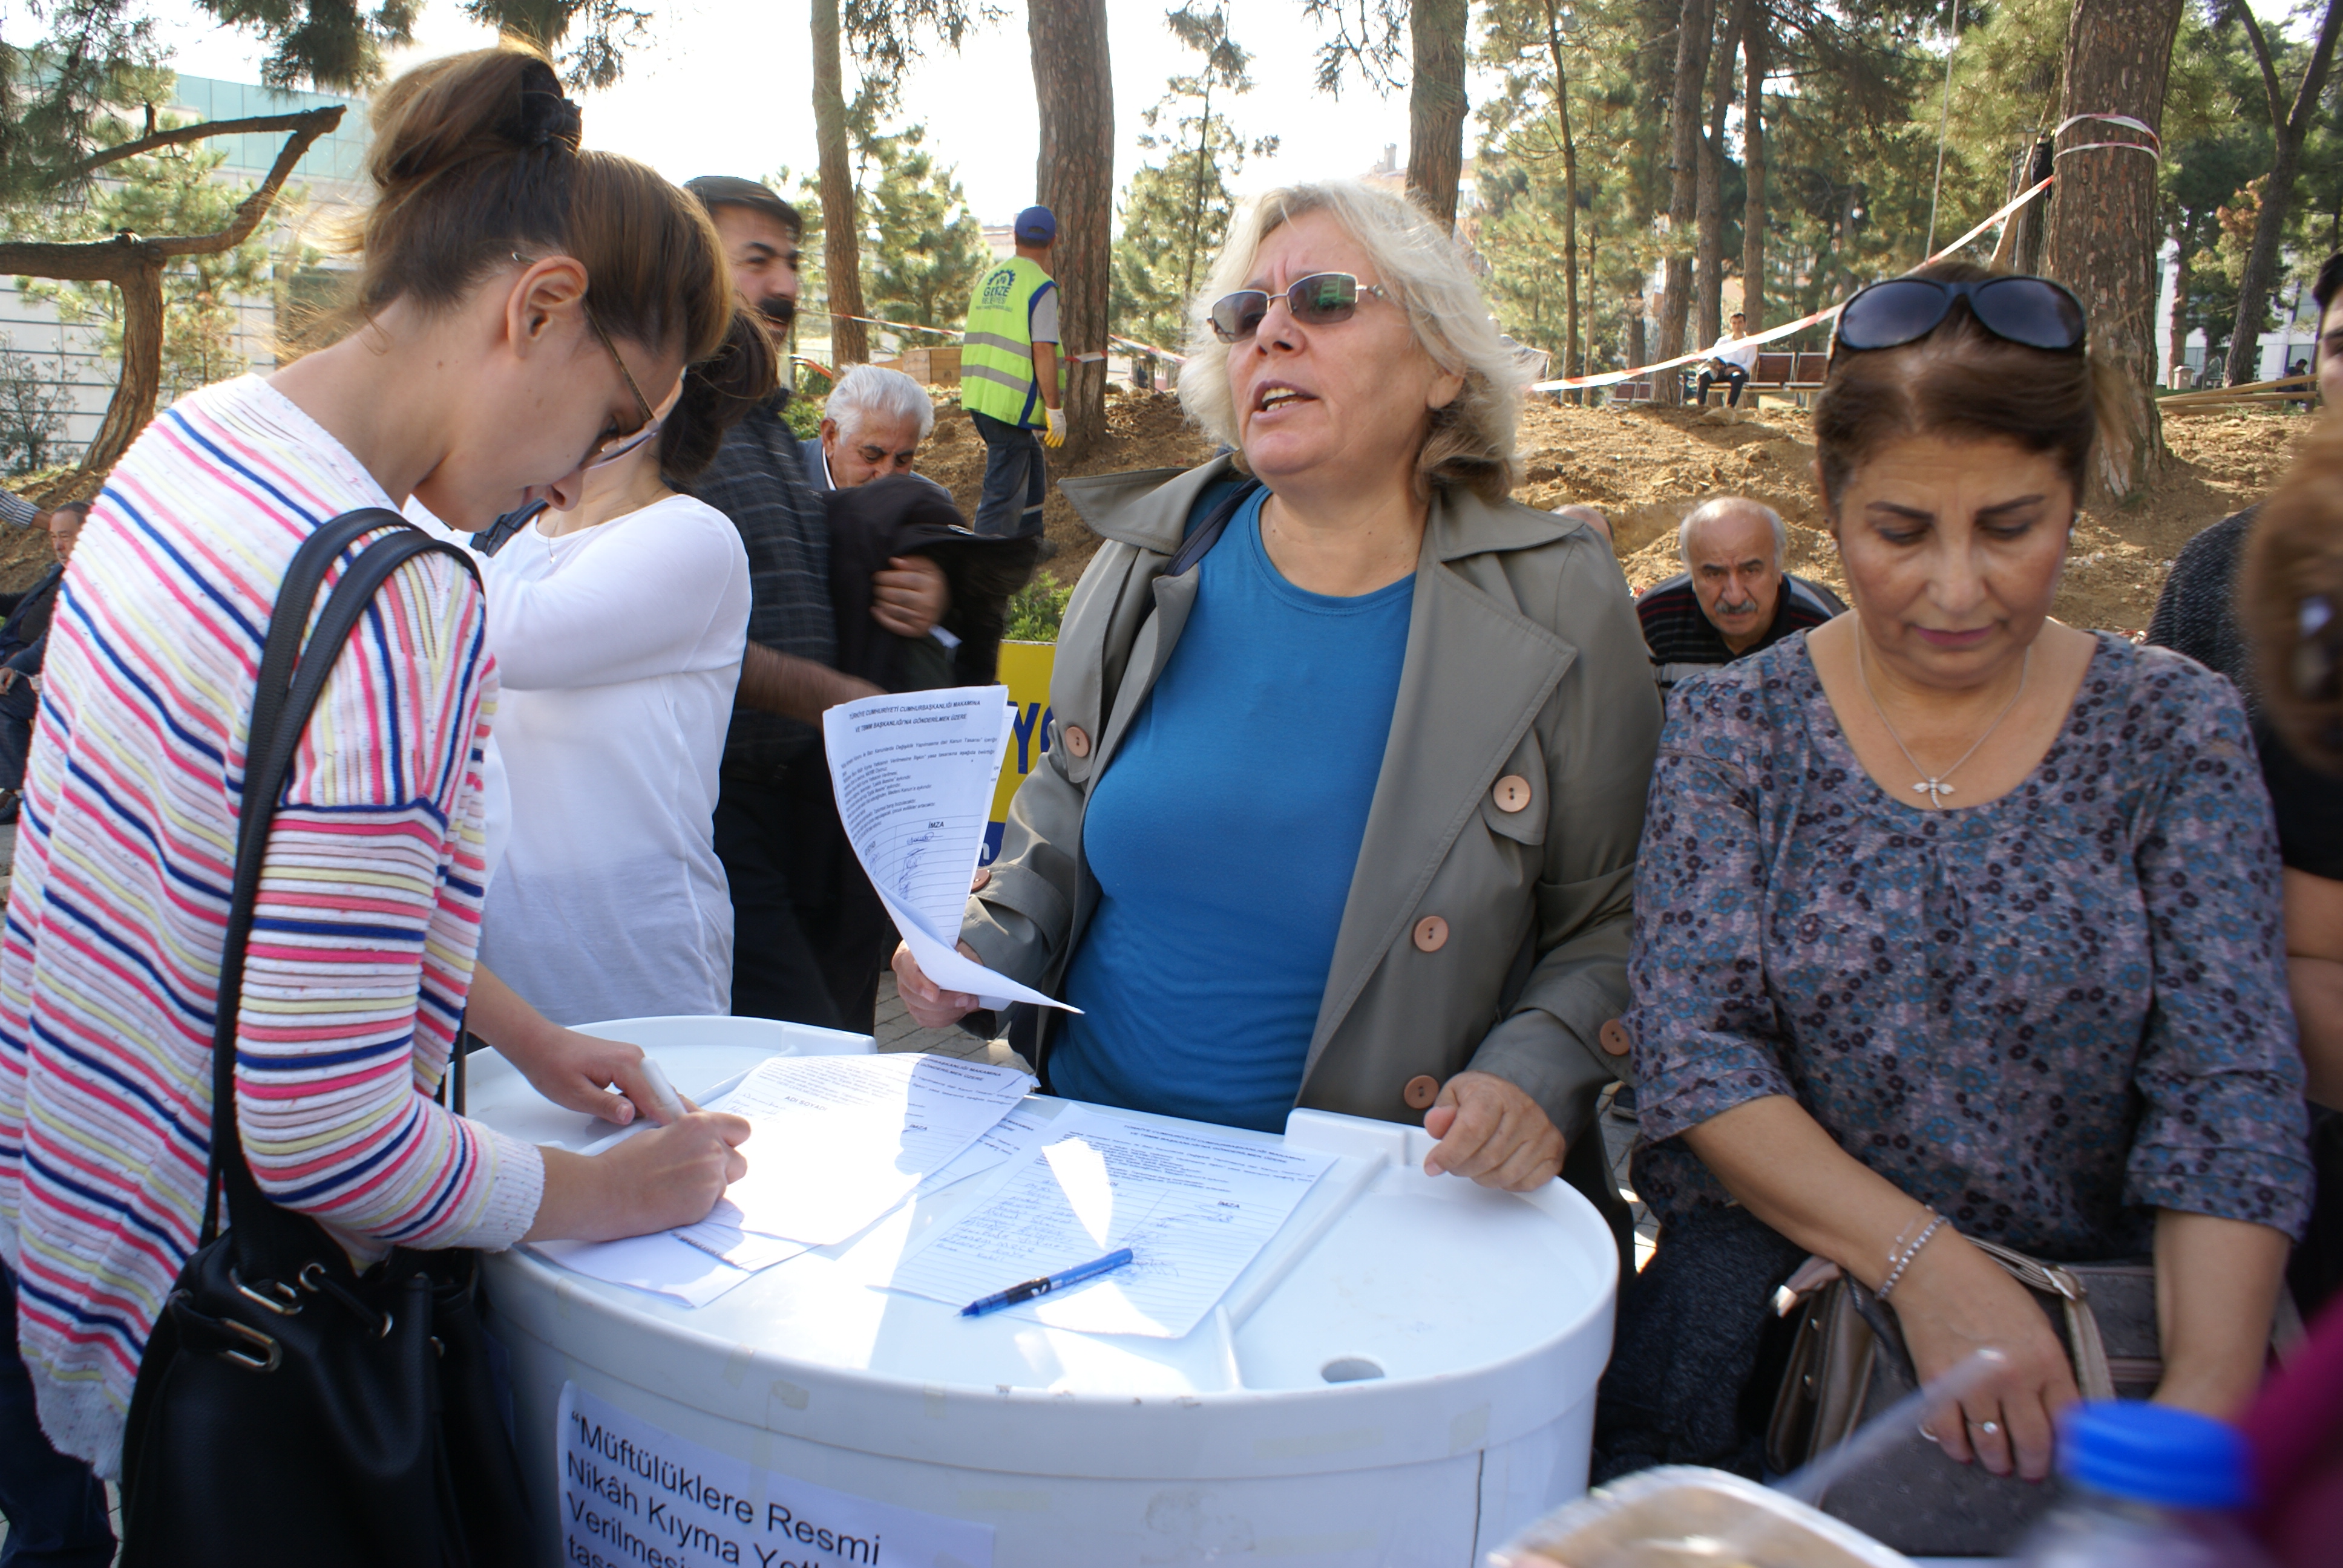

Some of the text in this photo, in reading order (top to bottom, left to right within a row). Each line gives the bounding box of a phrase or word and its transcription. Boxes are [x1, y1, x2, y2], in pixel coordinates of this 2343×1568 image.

[984, 286, 1011, 296] GZE
[865, 705, 899, 716] CUMHURİYETİ
[913, 714, 950, 725] GÖNDERİLMEK
[951, 713, 967, 721] ÜZERE
[920, 1063, 962, 1076] GÖNDERİLMEK
[799, 1099, 828, 1111] SOYADI
[571, 1411, 880, 1566] “Müftülüklere Resmi
[568, 1450, 739, 1566] Nikâh Kıyma
[569, 1534, 618, 1568] tas
